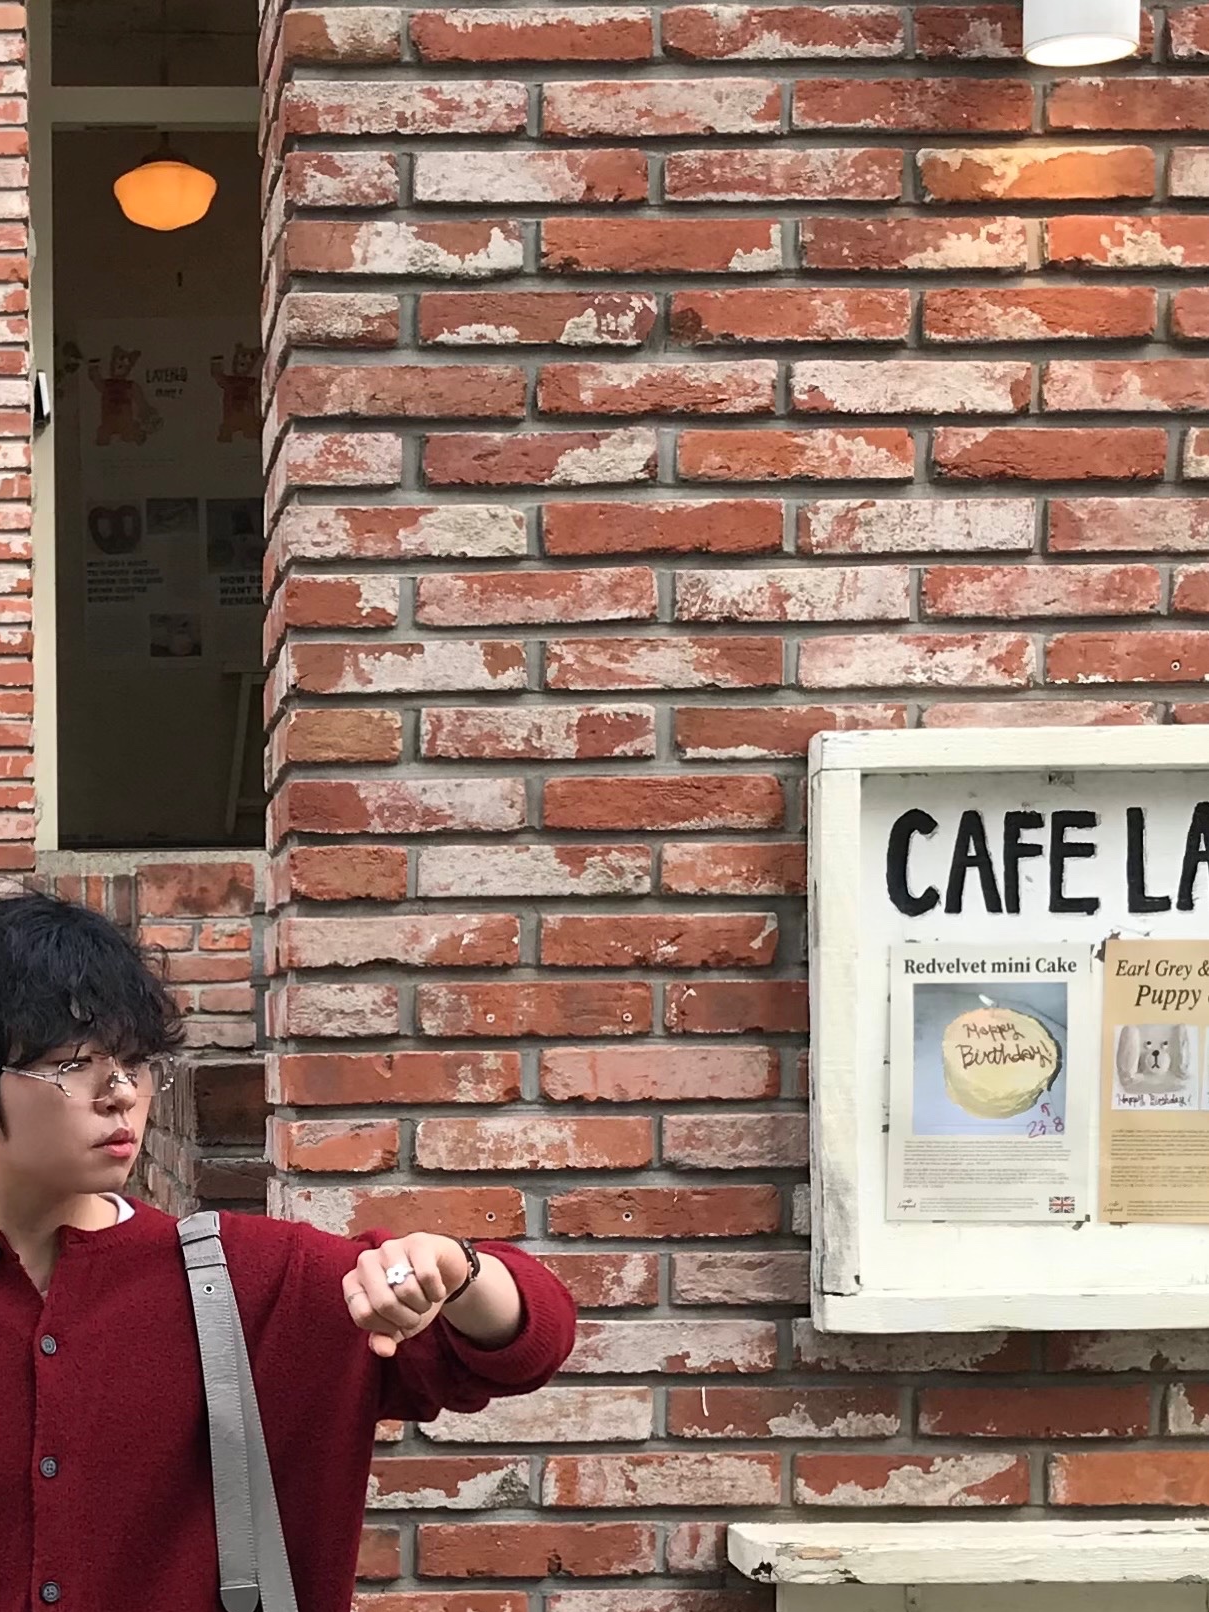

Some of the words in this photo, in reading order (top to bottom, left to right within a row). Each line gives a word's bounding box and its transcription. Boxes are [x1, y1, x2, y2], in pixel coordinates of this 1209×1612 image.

[886, 808, 1100, 917] CAFE
[904, 958, 986, 974] Redvelvet
[991, 957, 1031, 973] mini
[1035, 957, 1077, 973] Cake
[1115, 959, 1151, 977] Earl
[1155, 959, 1193, 981] Grey
[1134, 984, 1202, 1011] Puppy
[962, 1022, 1025, 1041] Happy
[955, 1040, 1053, 1070] Birthday!
